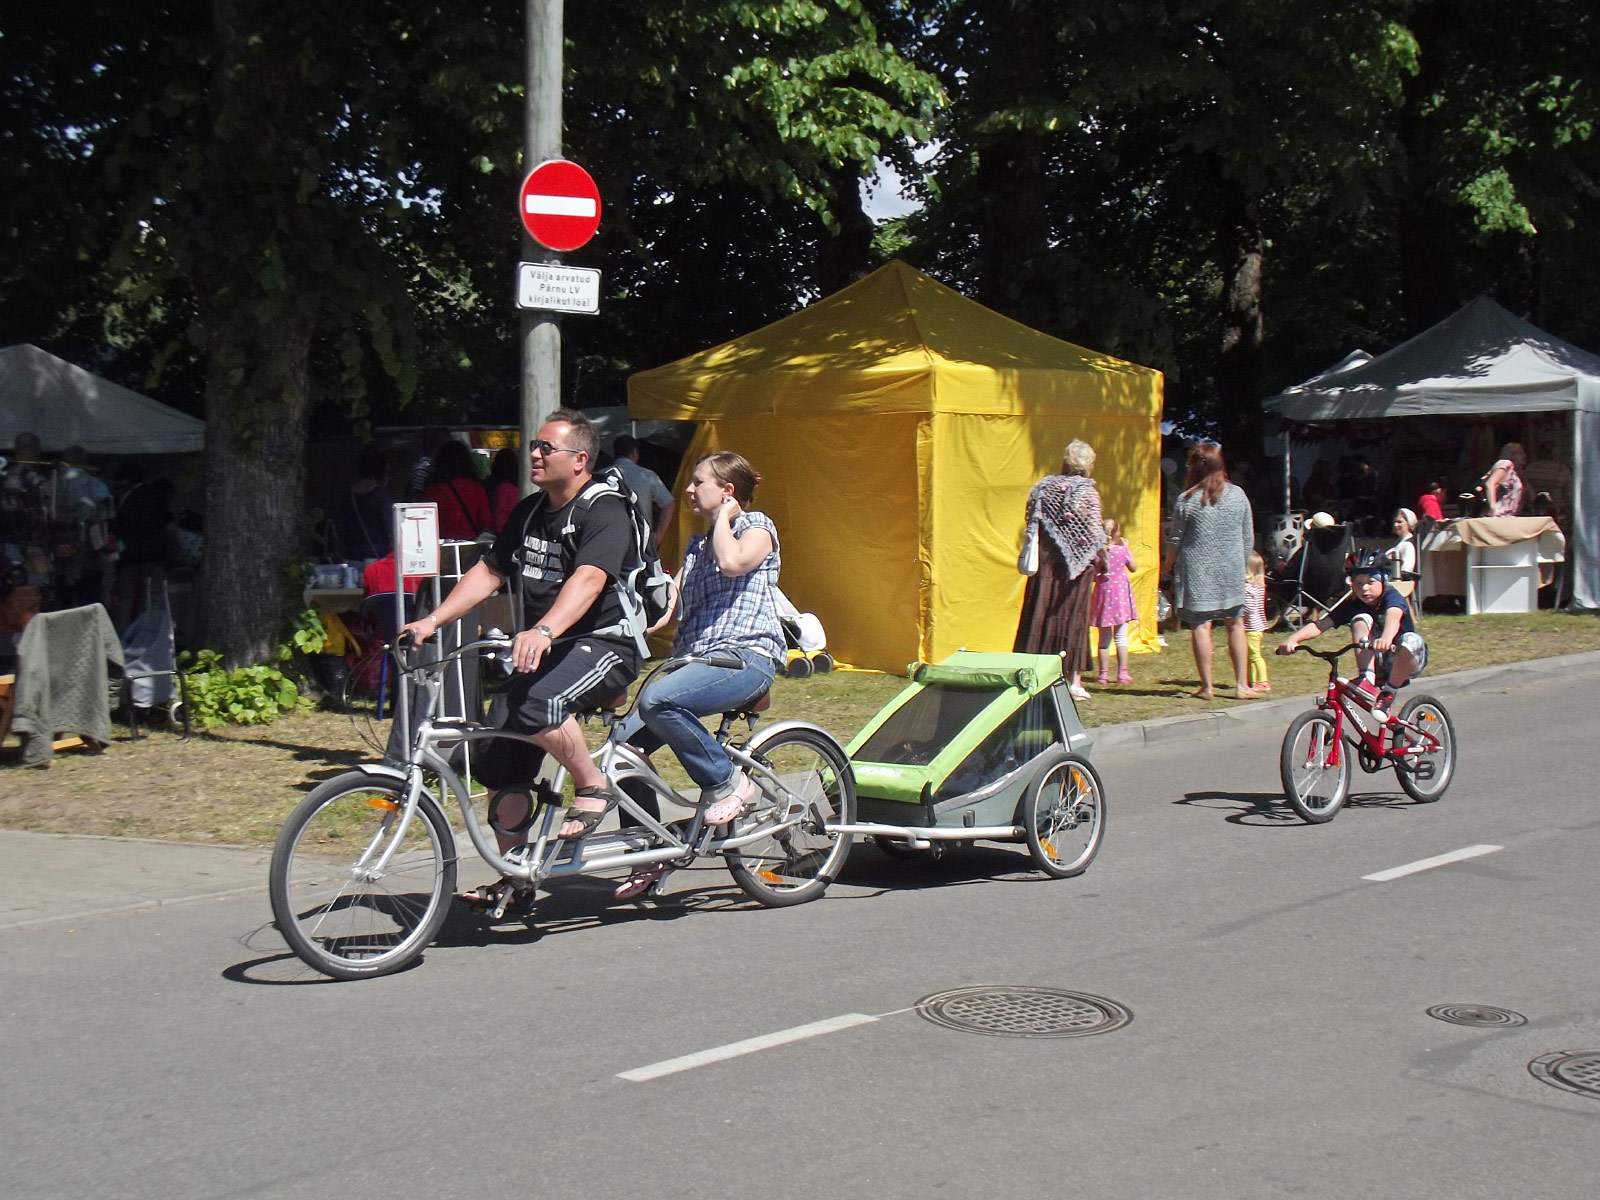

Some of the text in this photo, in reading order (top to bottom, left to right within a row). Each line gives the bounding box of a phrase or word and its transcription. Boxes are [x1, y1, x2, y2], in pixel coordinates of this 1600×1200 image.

[530, 270, 591, 284] Välja arvatud
[540, 283, 580, 294] Pärnu LV
